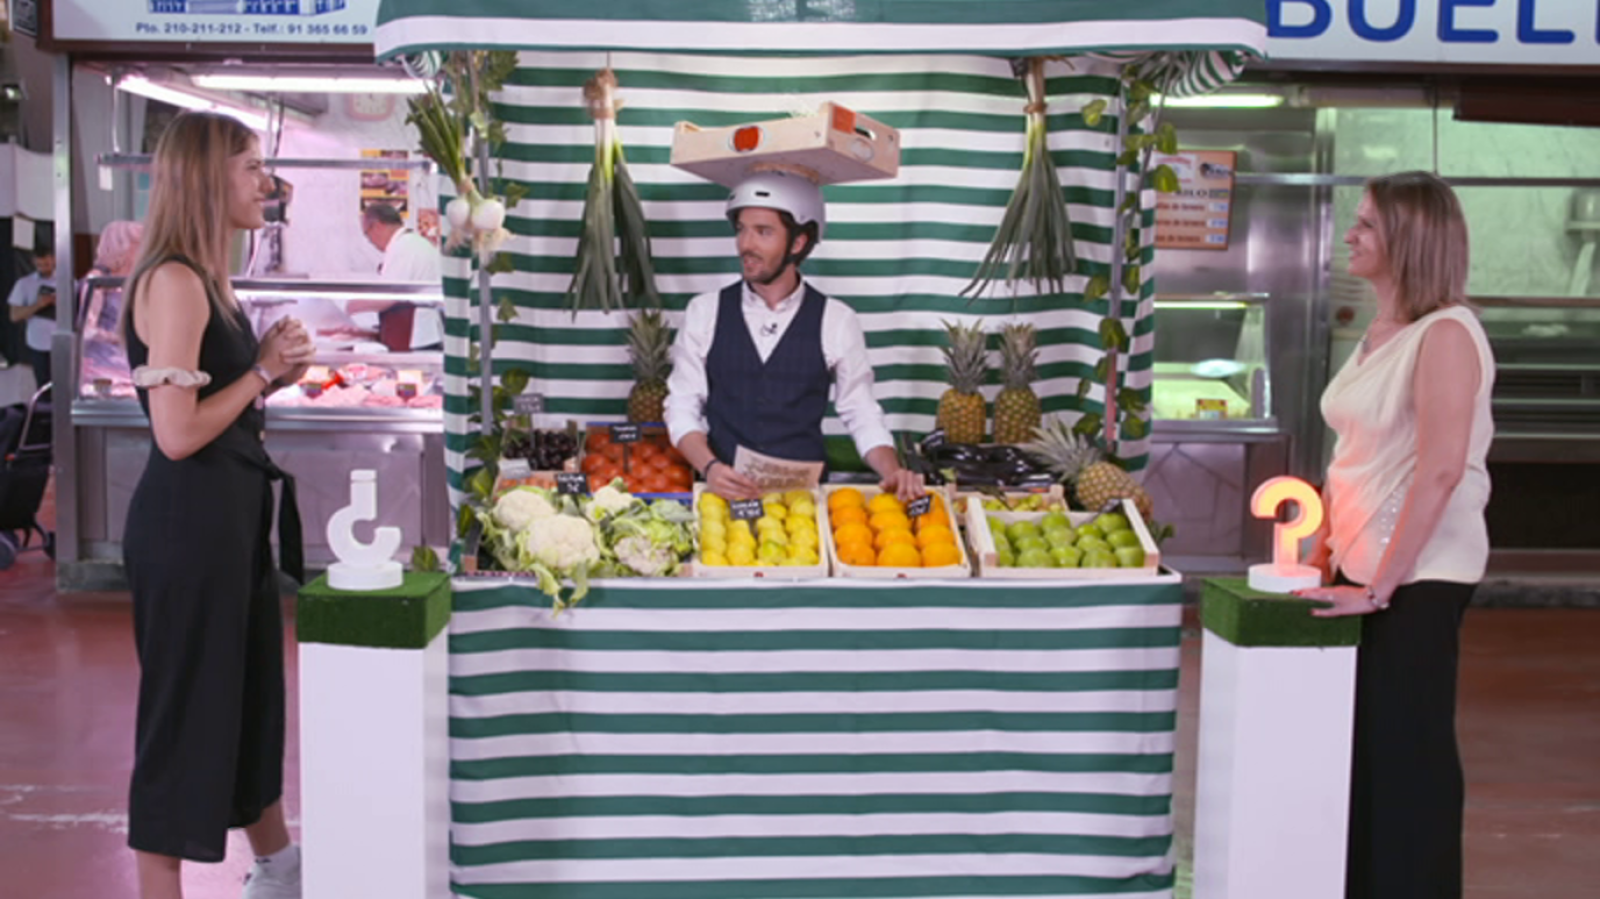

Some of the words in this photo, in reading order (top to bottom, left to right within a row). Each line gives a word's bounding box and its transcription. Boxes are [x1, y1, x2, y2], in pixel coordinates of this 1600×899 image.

[135, 22, 158, 34] Pto.
[164, 22, 242, 34] 210-211-212
[287, 23, 302, 35] 91
[332, 24, 349, 35] 66
[1265, 0, 1600, 45] BUEL
